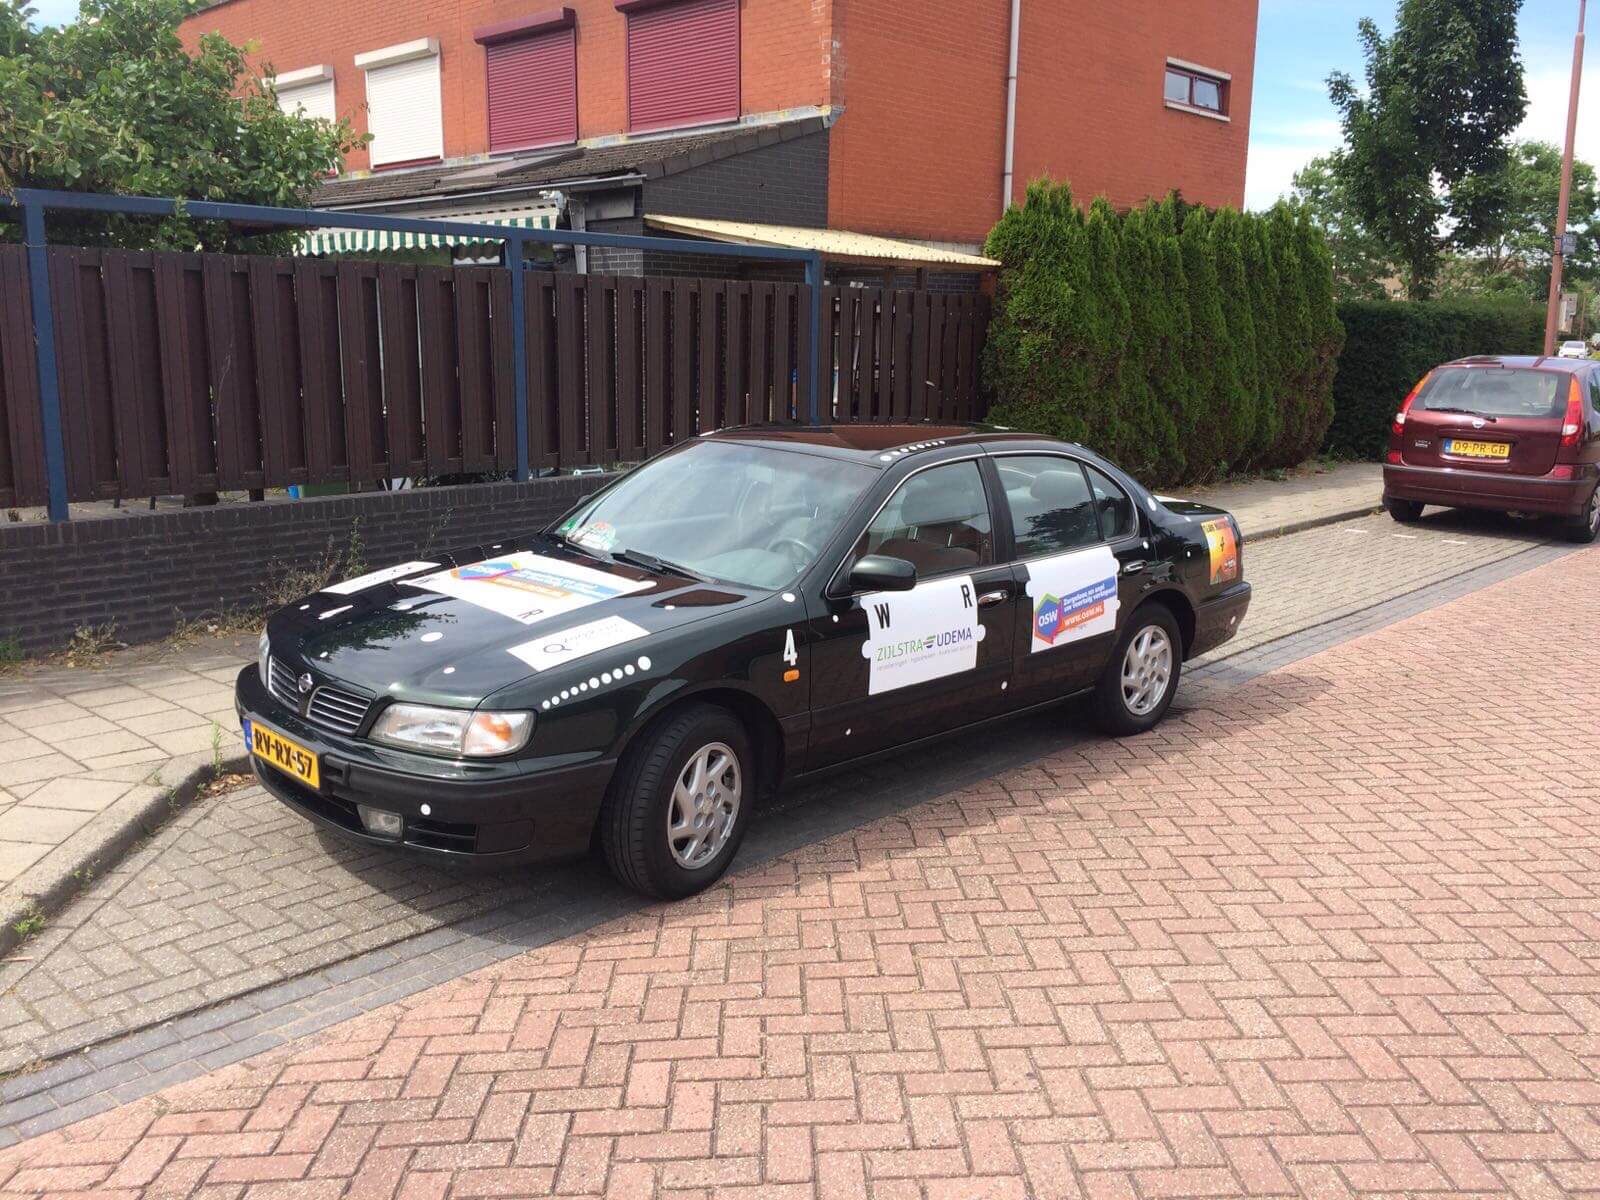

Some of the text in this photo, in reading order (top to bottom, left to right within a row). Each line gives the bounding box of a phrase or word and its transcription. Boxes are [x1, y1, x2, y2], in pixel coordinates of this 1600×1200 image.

[1454, 441, 1506, 455] 09-PR-GB
[874, 584, 973, 629] W R
[1038, 608, 1058, 627] OSW
[783, 628, 798, 667] 4
[876, 639, 924, 662] ZIJLSTRA
[936, 626, 973, 647] UDEMA
[254, 727, 313, 779] RV-RX-57
